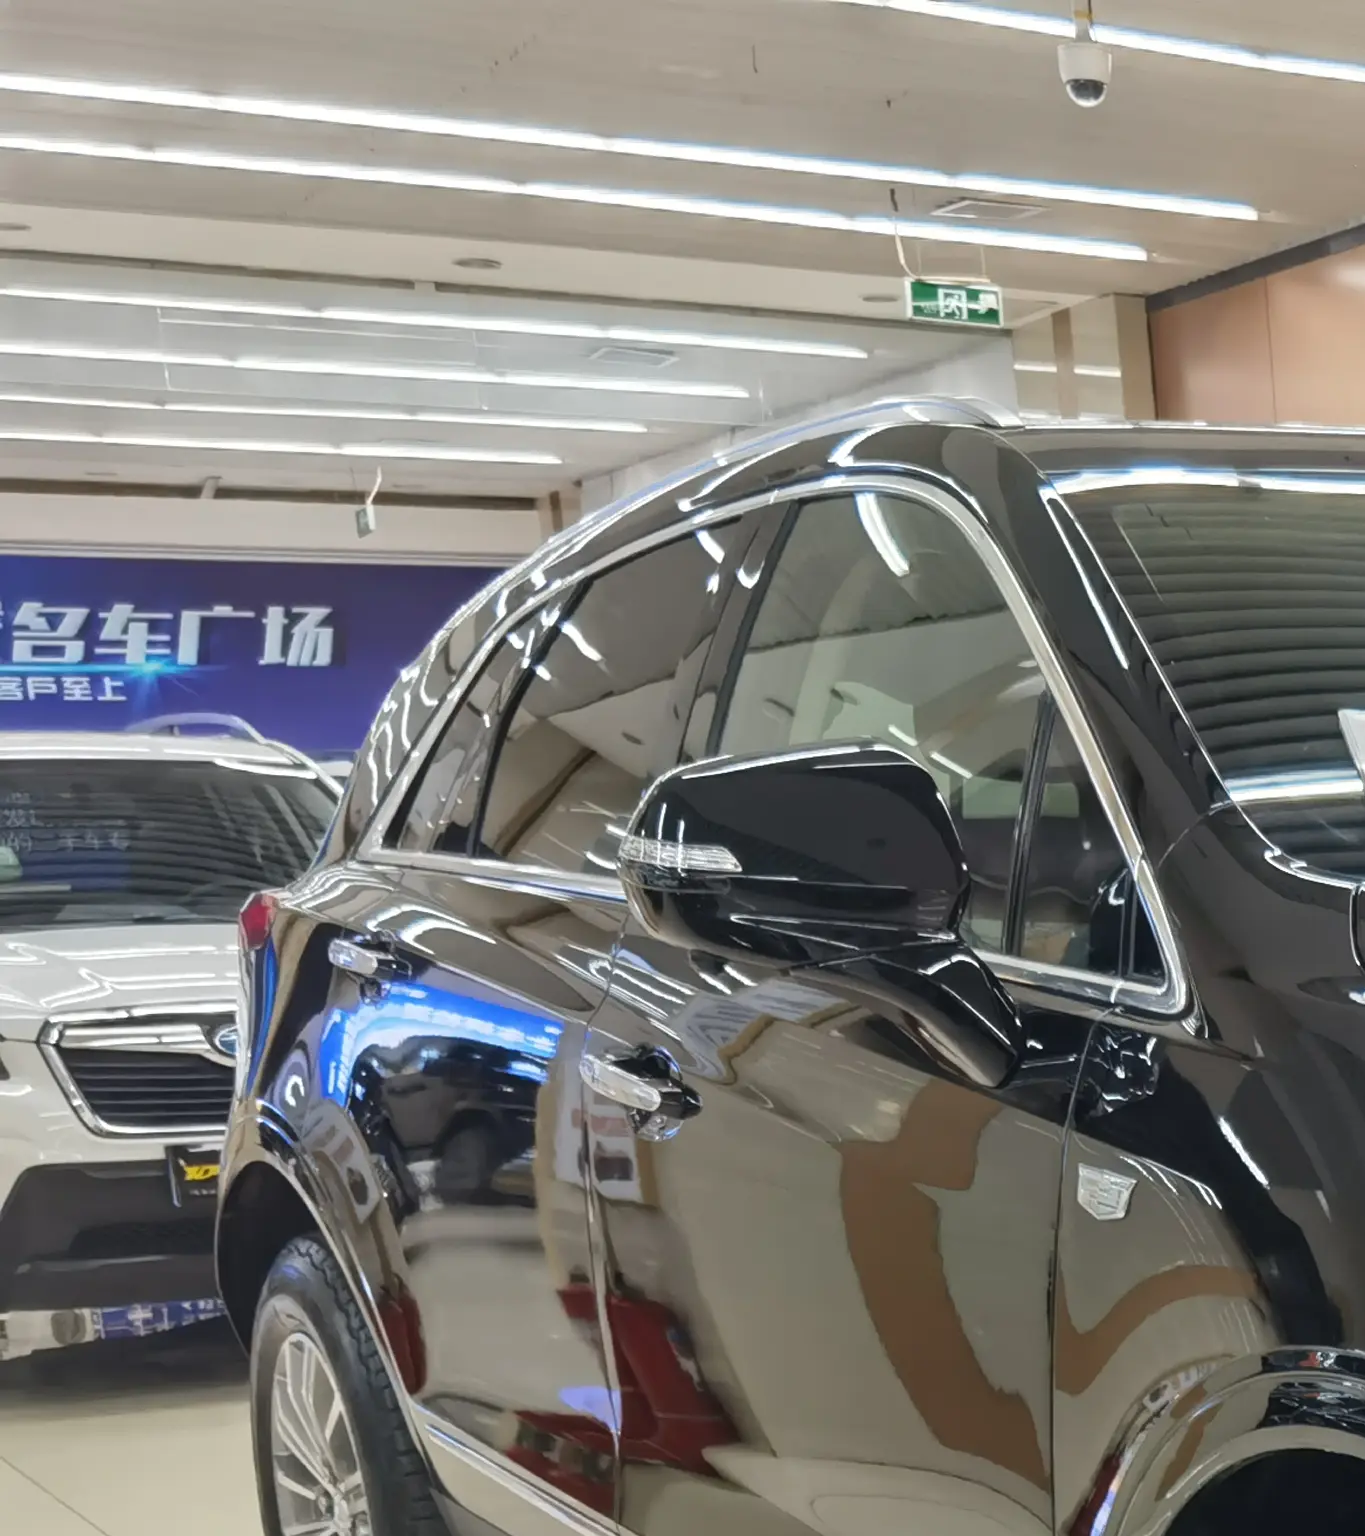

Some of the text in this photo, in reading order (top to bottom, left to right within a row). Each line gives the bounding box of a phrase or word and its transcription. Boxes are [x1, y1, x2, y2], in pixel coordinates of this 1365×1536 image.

[0, 601, 334, 667] 名车广场
[0, 676, 127, 701] 客户至上
